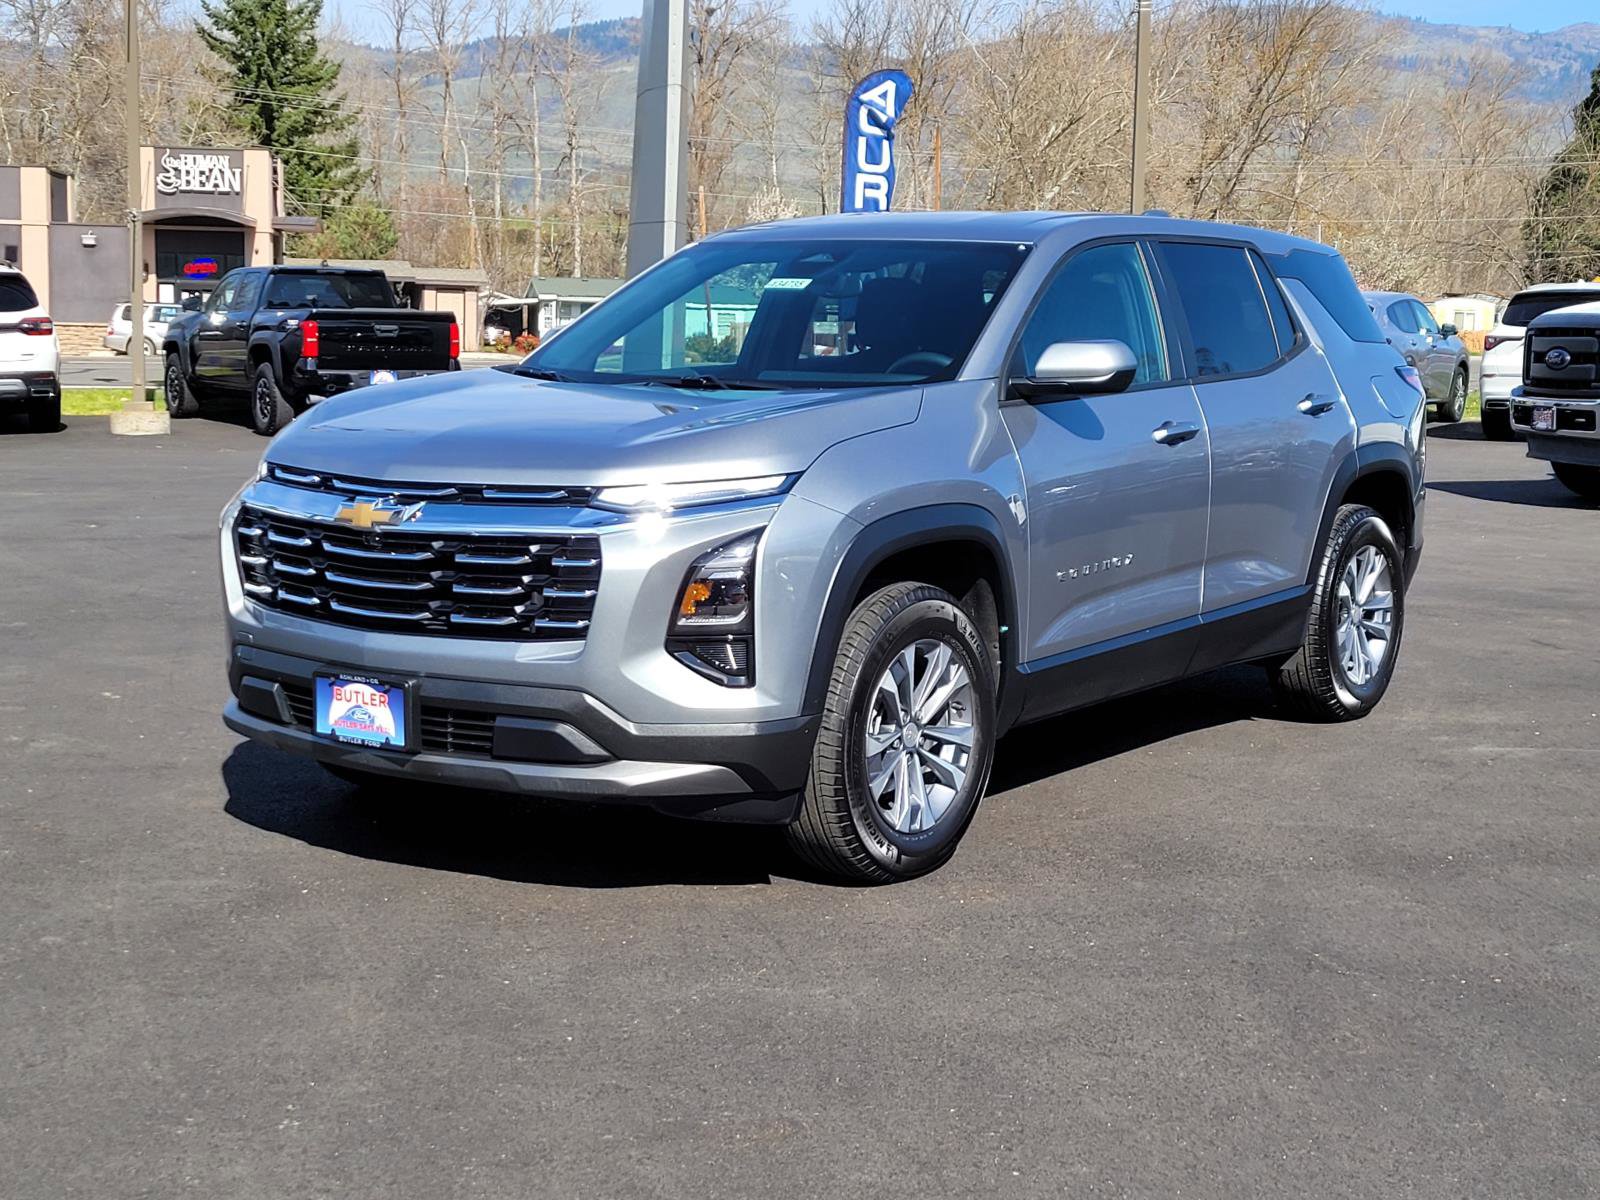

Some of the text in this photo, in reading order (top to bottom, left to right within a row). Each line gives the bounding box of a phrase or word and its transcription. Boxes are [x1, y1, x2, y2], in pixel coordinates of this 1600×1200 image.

[179, 153, 230, 169] HUMAN
[179, 167, 242, 194] BEAN
[335, 687, 388, 708] BUTLER
[339, 735, 381, 748] BUTLER FORD
